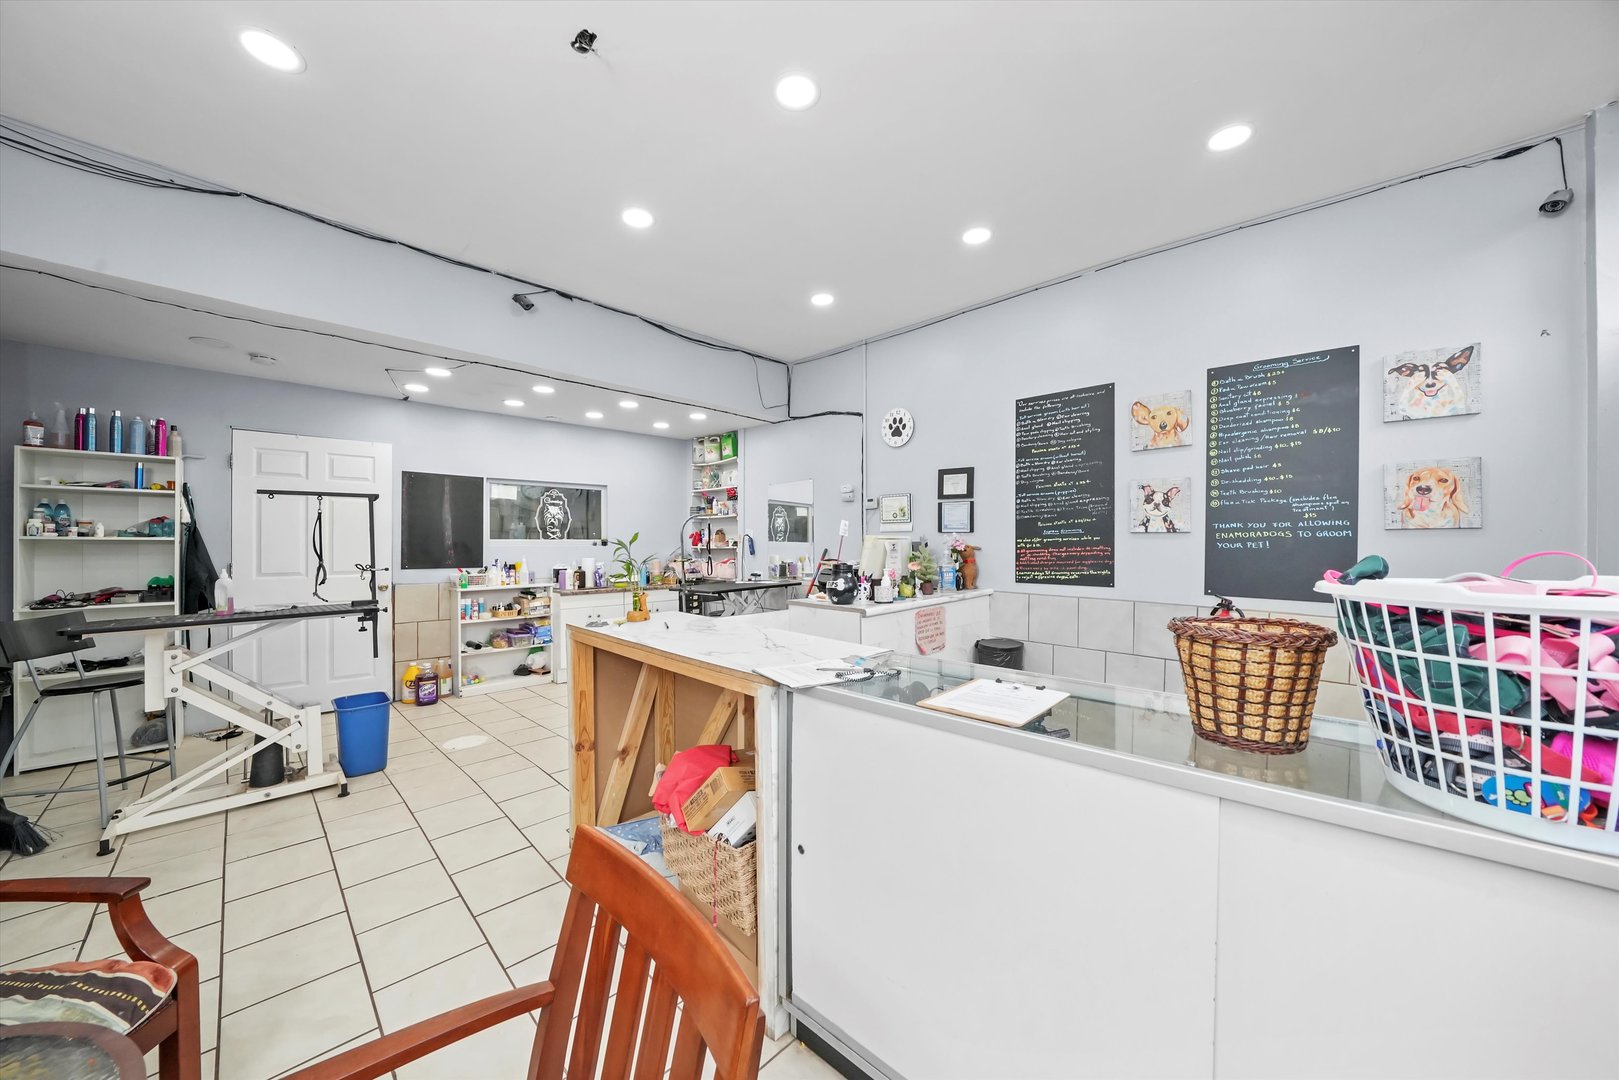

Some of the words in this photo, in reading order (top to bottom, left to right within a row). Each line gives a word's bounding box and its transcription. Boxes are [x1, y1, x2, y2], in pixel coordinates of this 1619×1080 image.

[1253, 362, 1289, 371] Grooming
[1292, 356, 1322, 364] Service
[1216, 530, 1292, 539] ENAMORADOGS
